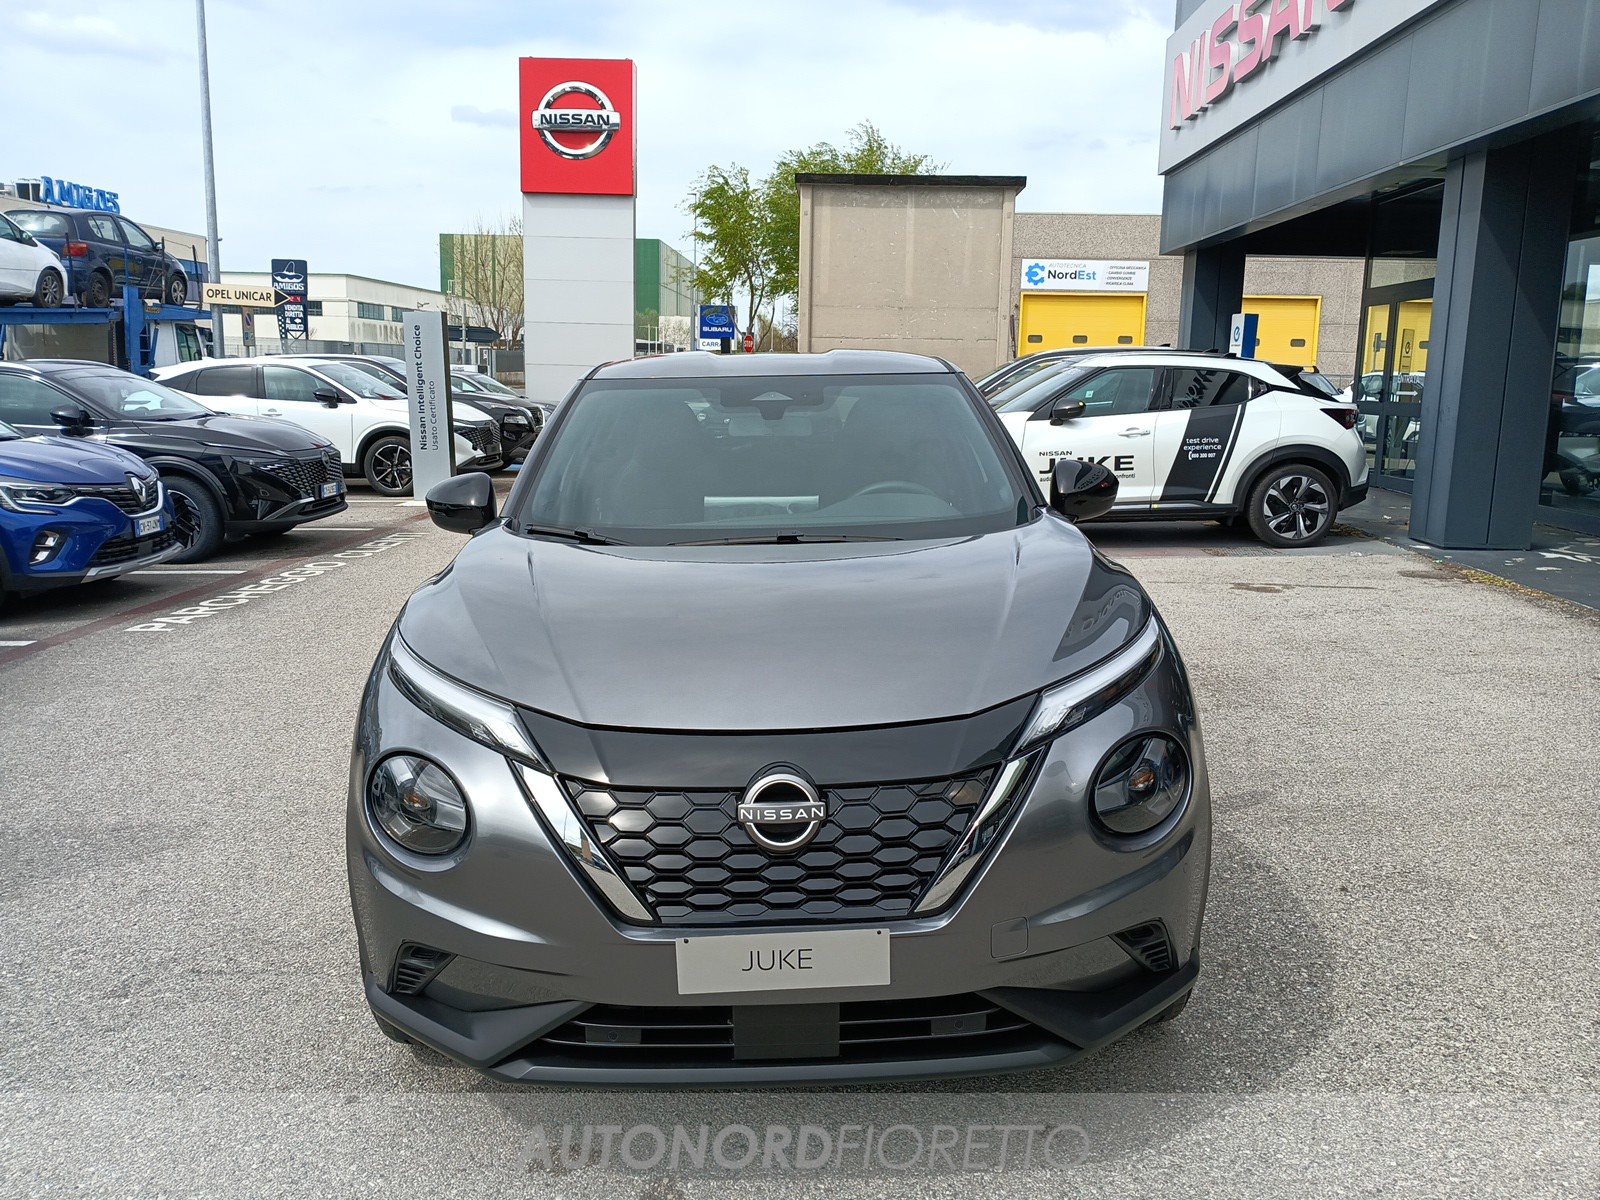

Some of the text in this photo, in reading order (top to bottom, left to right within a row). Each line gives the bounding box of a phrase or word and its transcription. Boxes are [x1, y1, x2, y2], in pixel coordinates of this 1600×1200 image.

[1170, 0, 1347, 129] NISSA
[540, 113, 610, 126] NISSAN
[40, 176, 120, 215] AMIGOS
[273, 282, 305, 291] AMIGOS
[1047, 269, 1097, 281] NordEst
[206, 288, 272, 302] OPEL UNICAR
[412, 324, 428, 450] Nissan Intelligent Choice
[428, 380, 438, 425] Certificato
[123, 561, 346, 632] PARCHEGGIO
[740, 806, 824, 820] NISSAN
[742, 948, 813, 972] JUKE
